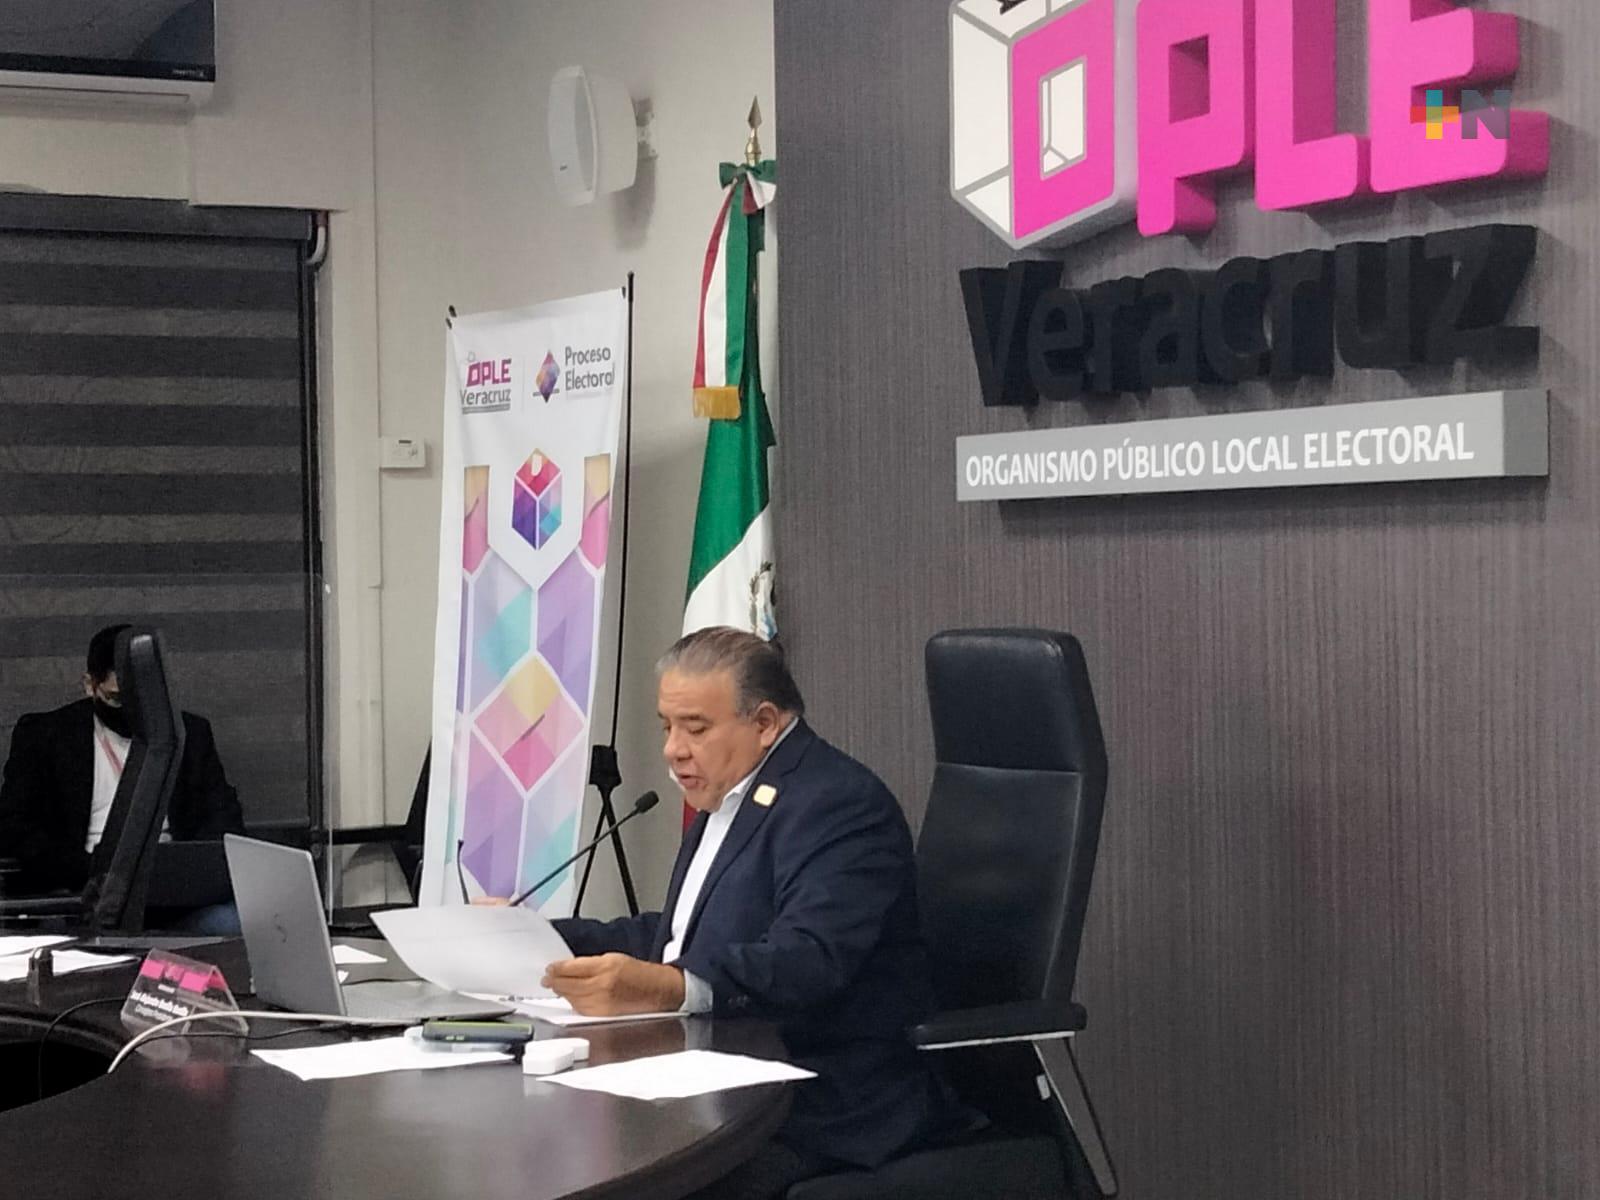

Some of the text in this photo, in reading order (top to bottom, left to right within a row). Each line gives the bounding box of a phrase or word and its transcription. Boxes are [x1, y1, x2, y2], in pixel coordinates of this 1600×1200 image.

[959, 223, 1541, 406] Veracruz
[565, 346, 612, 367] Proceso
[466, 358, 512, 388] OPLE
[565, 362, 616, 391] Electoral
[460, 388, 512, 405] Veracruz
[966, 422, 1475, 487] ORGANISMO PÚBLICO LOCAL ELECTORAL
